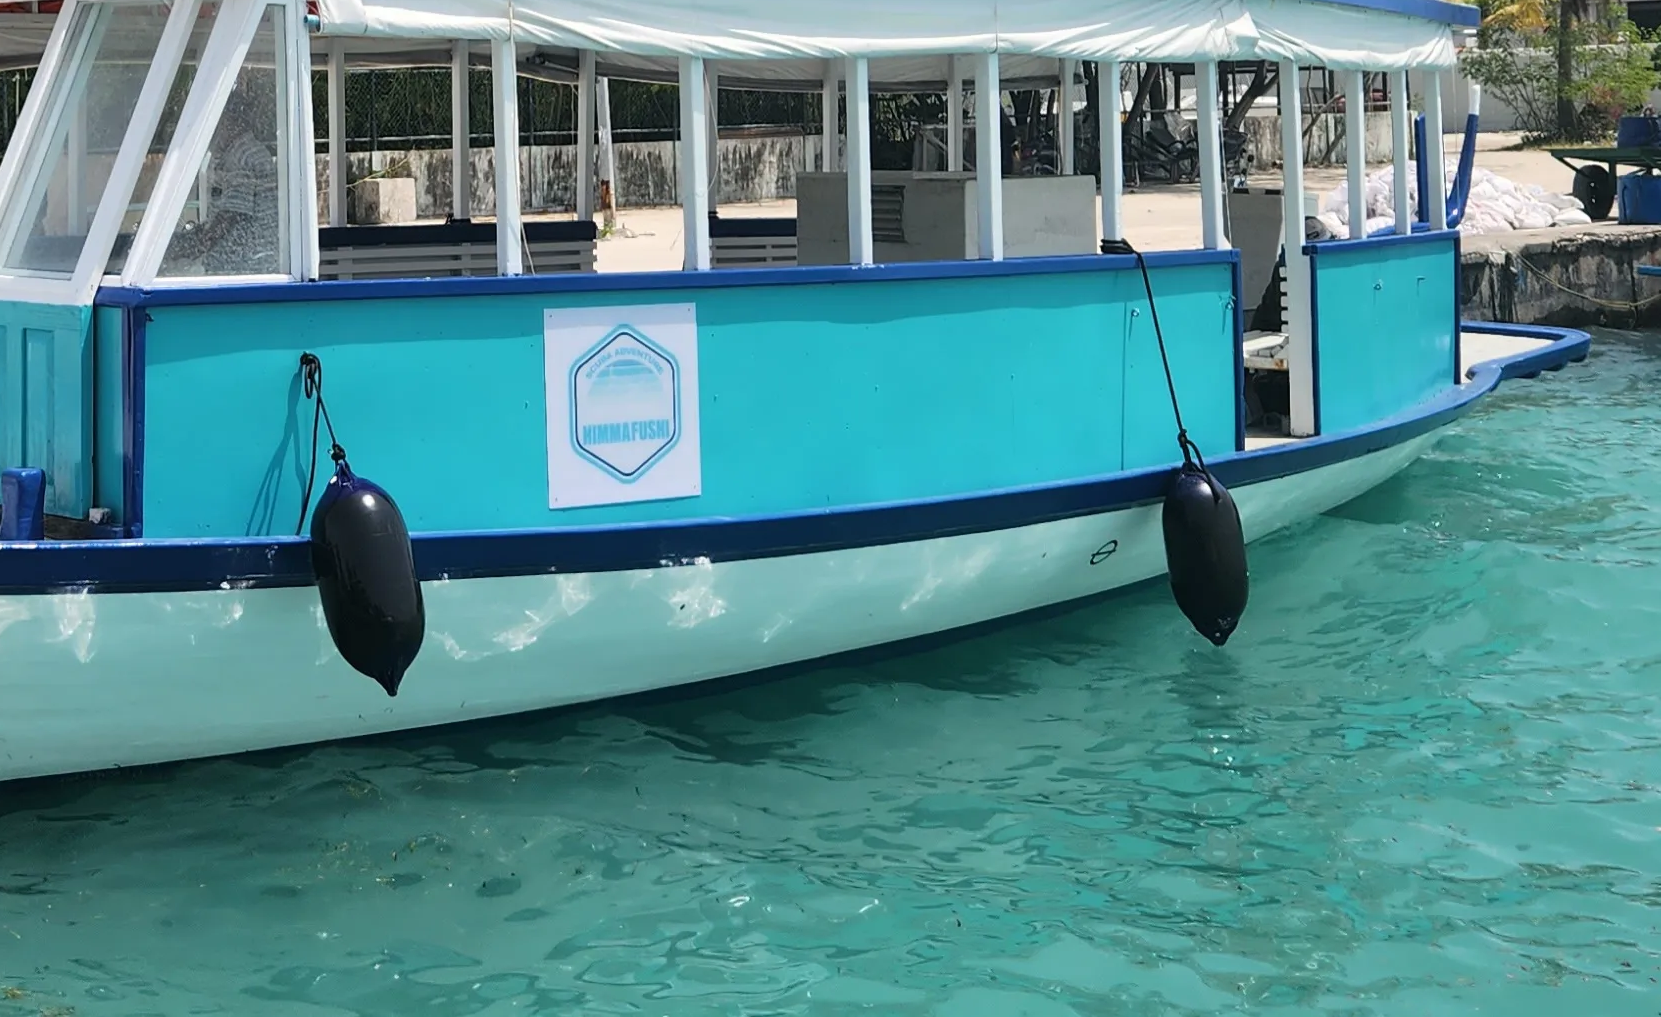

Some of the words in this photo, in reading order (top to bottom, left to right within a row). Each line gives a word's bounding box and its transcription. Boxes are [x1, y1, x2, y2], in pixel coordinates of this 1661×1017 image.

[585, 351, 613, 380] SCUBA
[614, 347, 664, 375] ADVENTURE
[582, 419, 670, 445] HIMMAFUSHI
